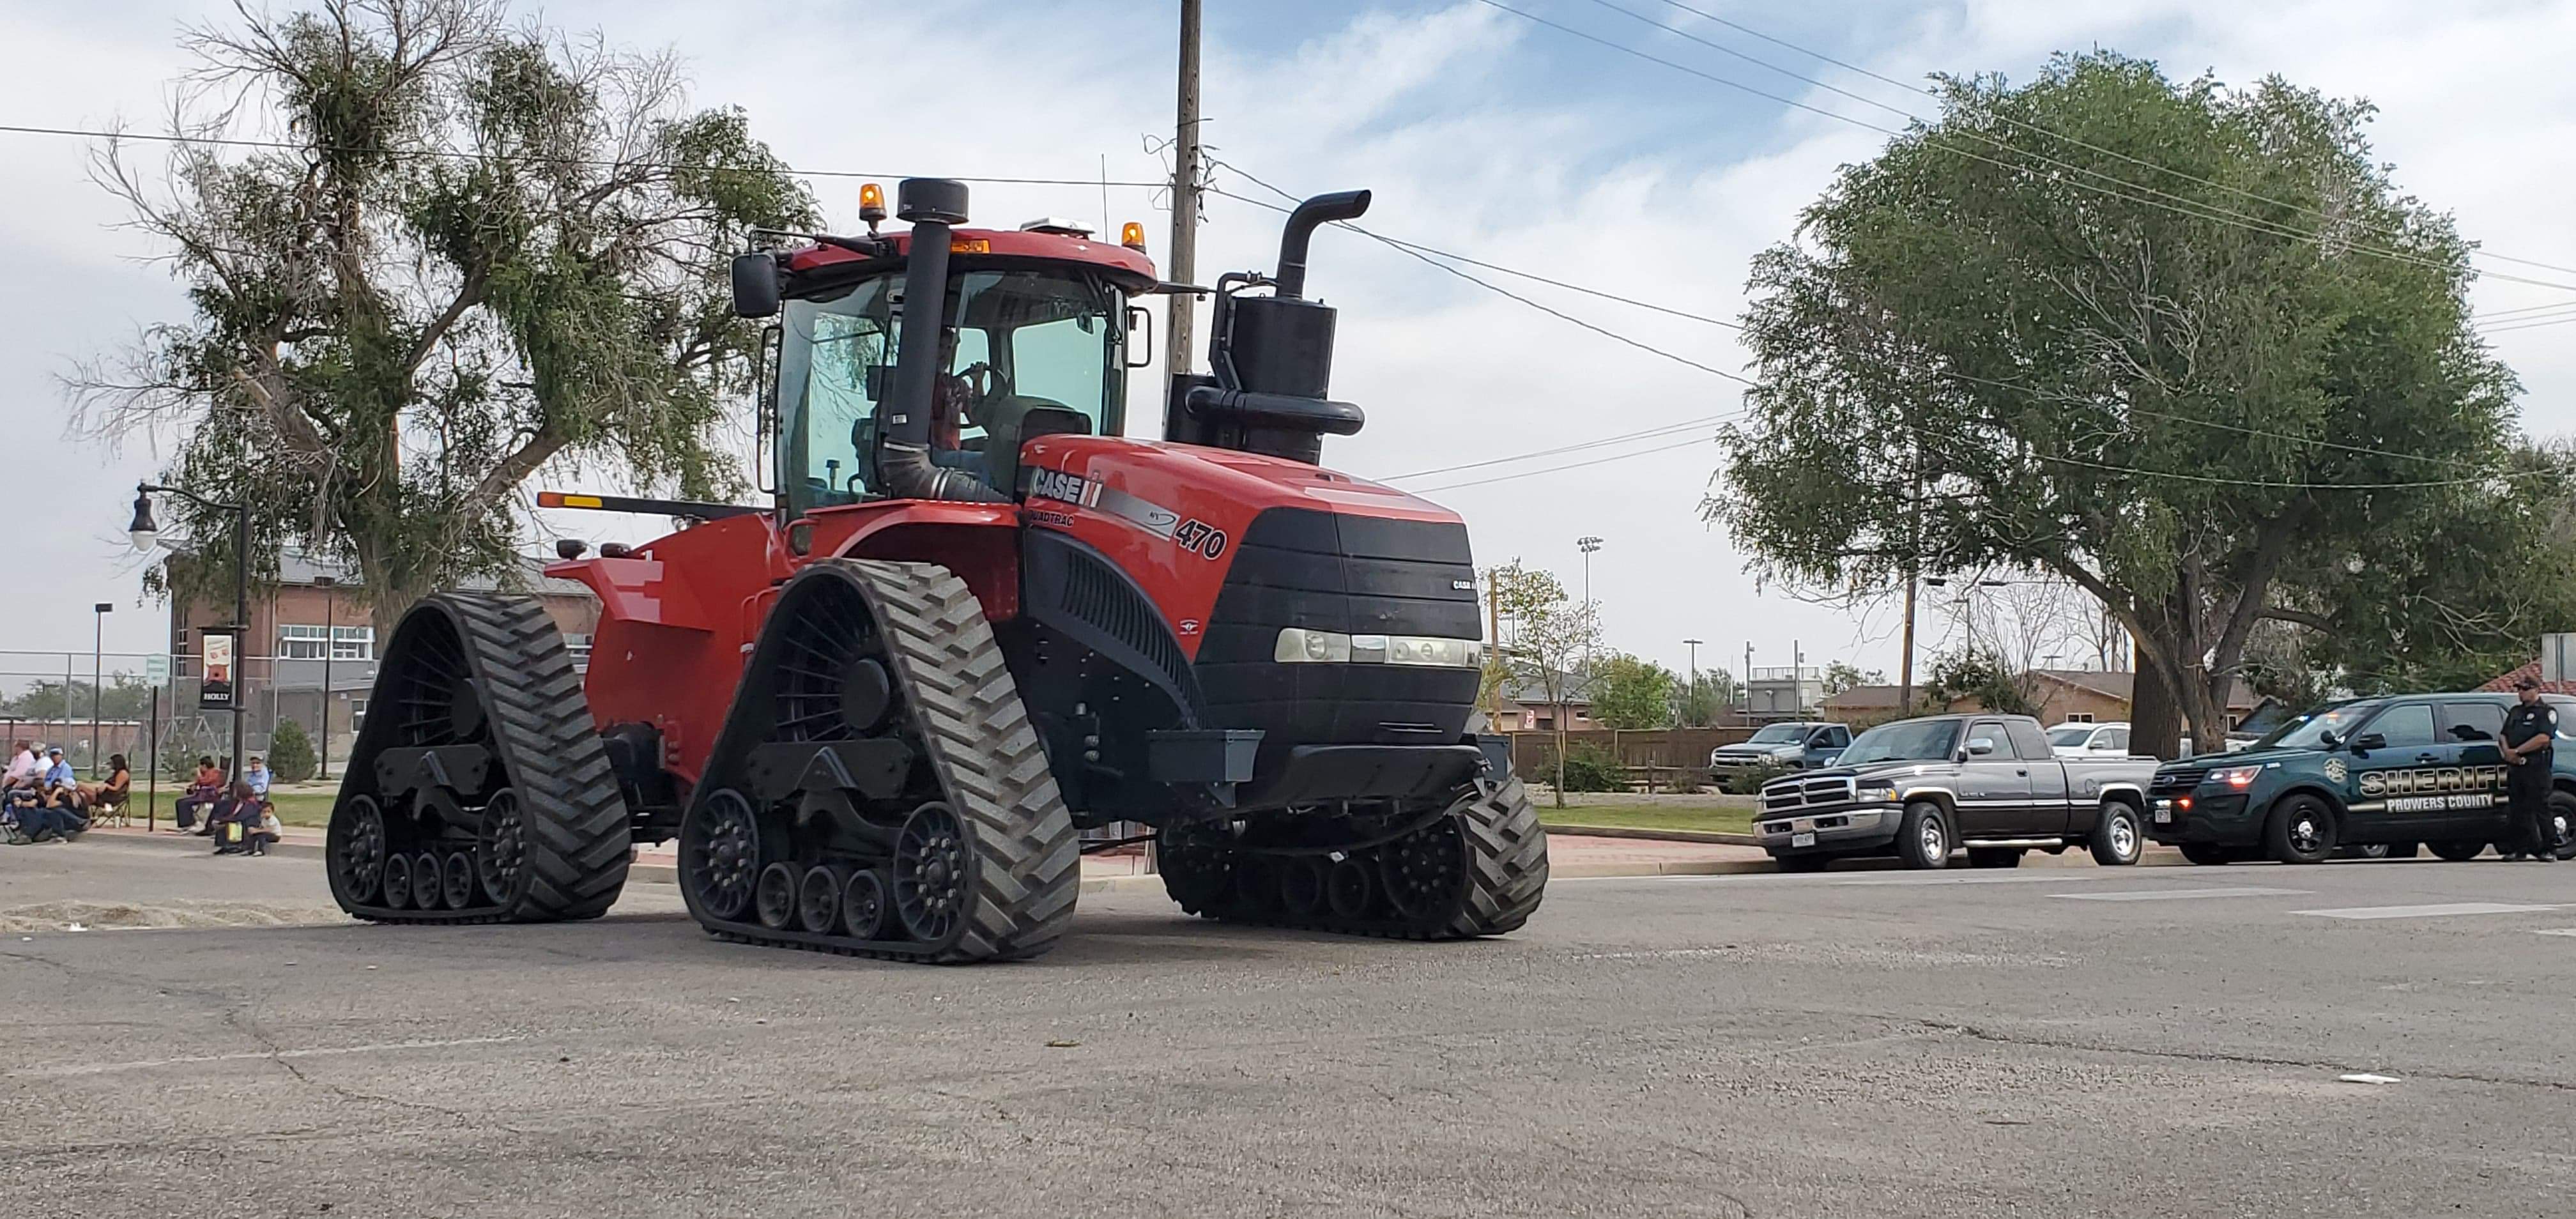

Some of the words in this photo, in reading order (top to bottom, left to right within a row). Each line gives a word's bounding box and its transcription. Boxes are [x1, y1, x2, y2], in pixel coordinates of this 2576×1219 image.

[1033, 467, 1082, 503] CASE
[1174, 518, 1227, 560] 470
[204, 693, 230, 701] HOLLY
[2386, 796, 2445, 813] PROWERS
[2448, 793, 2492, 808] COUNTY
